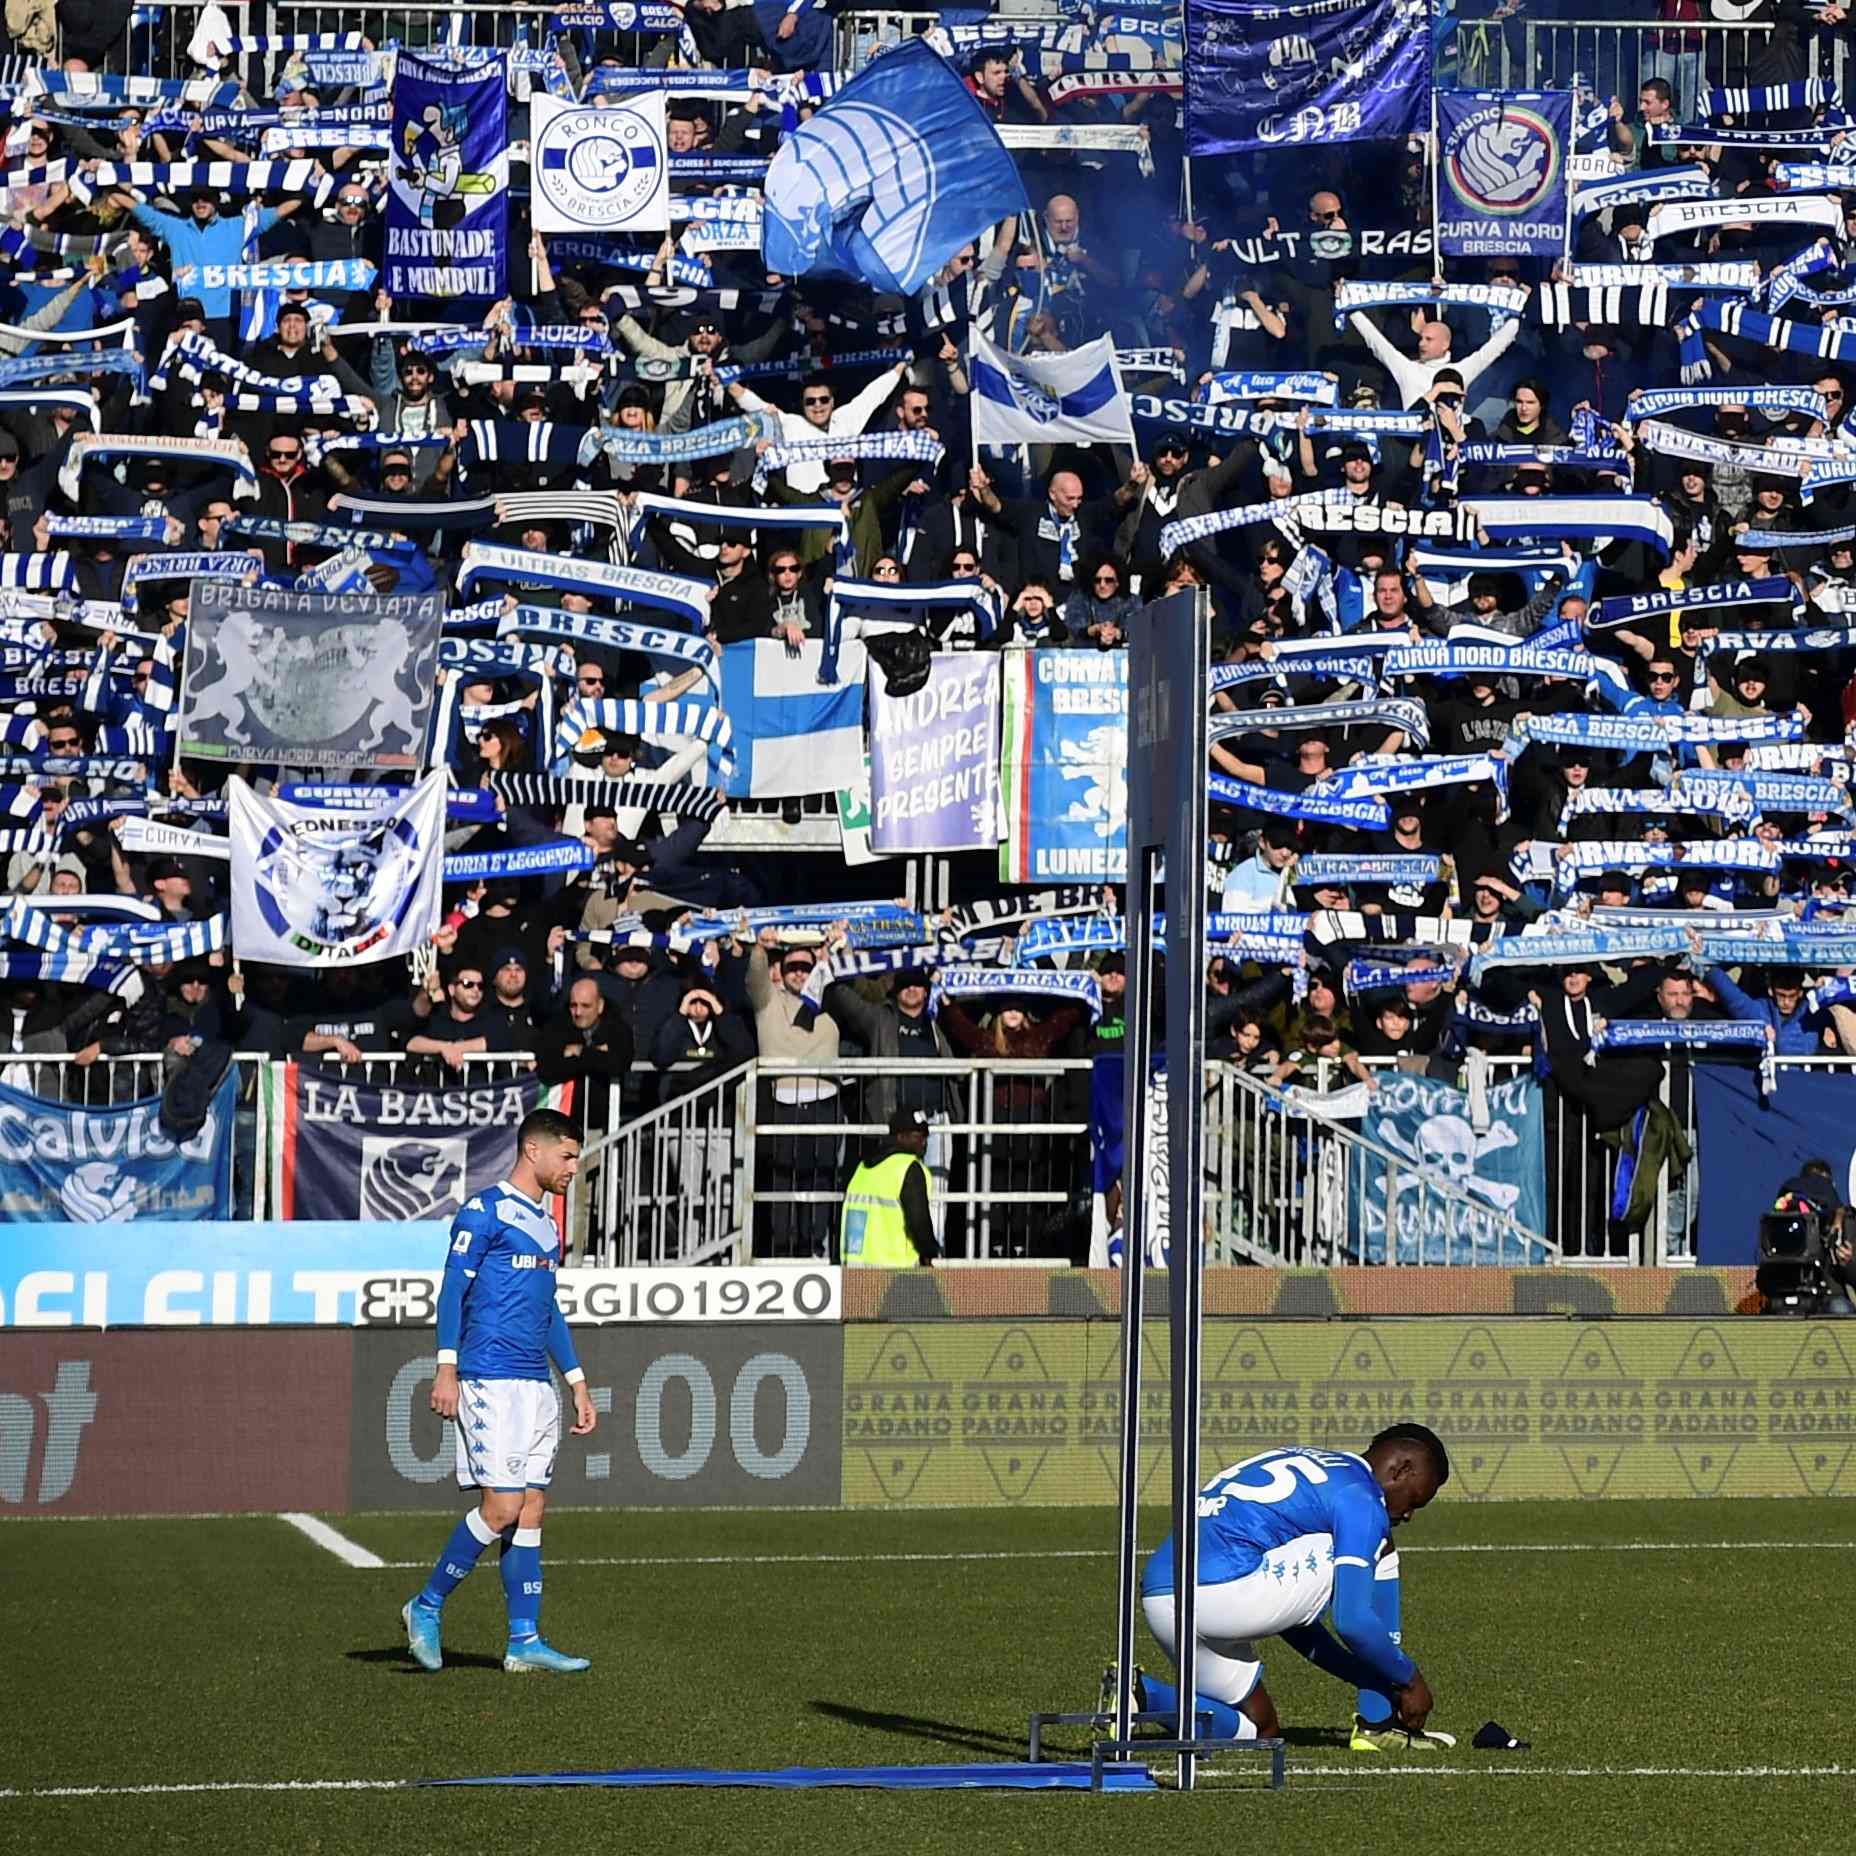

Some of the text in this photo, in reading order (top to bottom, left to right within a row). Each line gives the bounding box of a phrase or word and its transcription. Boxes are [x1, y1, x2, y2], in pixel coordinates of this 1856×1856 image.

[561, 116, 639, 140] RONCO
[567, 196, 632, 217] BRESCIA
[1437, 221, 1564, 240] CURVA NORD
[388, 228, 496, 257] BASTUNADE
[1462, 240, 1532, 254] BRESCIA
[203, 262, 345, 288] BRESCIA
[392, 269, 404, 292] E
[201, 587, 310, 614] BRIGATA
[1631, 583, 1752, 607] BRESCIA
[887, 729, 989, 784] SEMPRE
[877, 763, 999, 829] PRESENTE
[304, 1081, 527, 1127] LA BASSA
[964, 1393, 1067, 1412] GRANA
[1541, 1390, 1645, 1409] GRANA
[963, 1417, 1067, 1436] PADANO
[1541, 1415, 1645, 1434] PADANO
